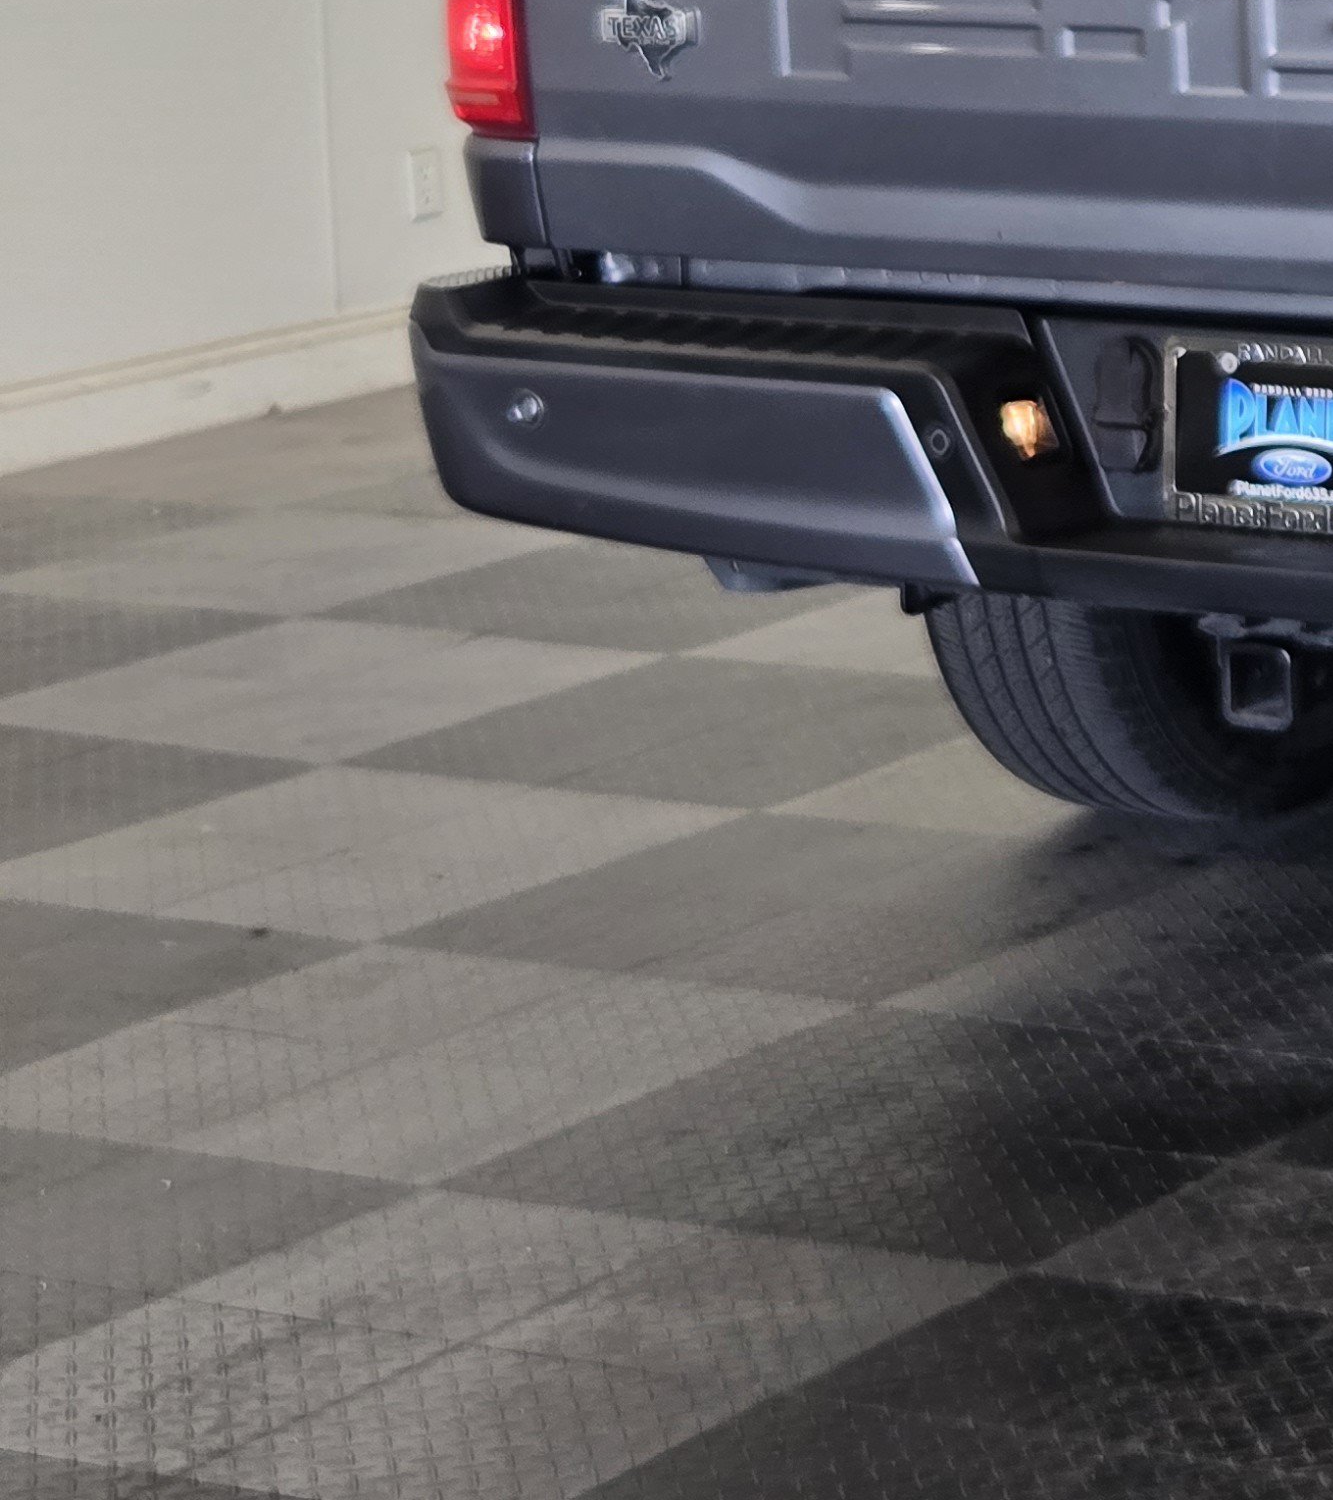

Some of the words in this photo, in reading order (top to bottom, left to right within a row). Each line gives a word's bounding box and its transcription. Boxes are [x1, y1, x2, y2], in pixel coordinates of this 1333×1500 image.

[607, 15, 677, 40] TEXAS
[1237, 342, 1330, 365] RANDALL
[1272, 456, 1319, 479] Ford
